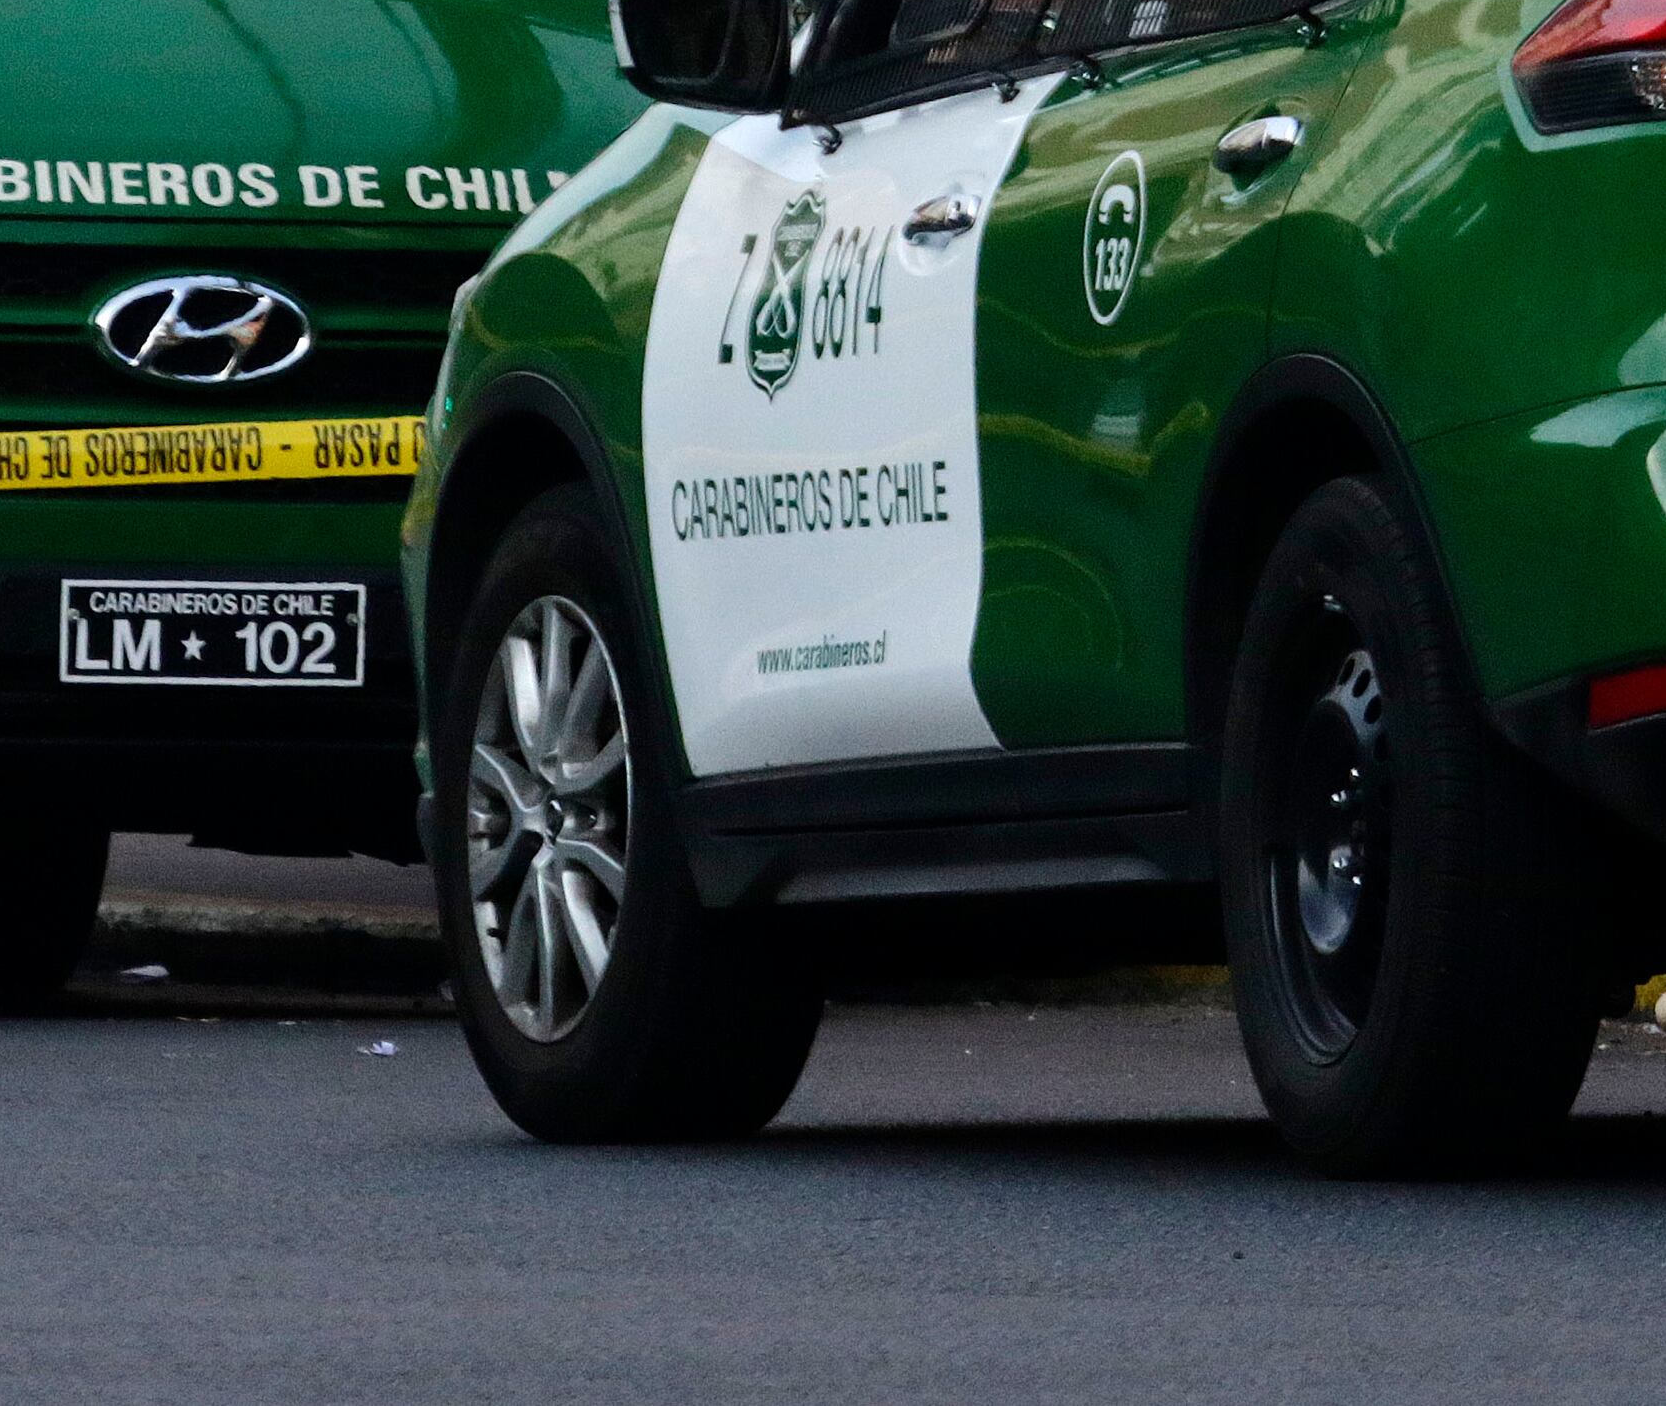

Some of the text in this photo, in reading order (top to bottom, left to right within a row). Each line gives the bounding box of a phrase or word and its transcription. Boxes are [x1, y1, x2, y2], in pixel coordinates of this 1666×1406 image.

[298, 165, 385, 209] DE
[1094, 237, 1132, 291] 133
[41, 435, 72, 478] DE
[85, 426, 262, 476] CARABINEROS
[313, 423, 400, 469] PASAR
[671, 460, 949, 542] CARABINEROS DE CHILE
[89, 591, 336, 617] CARABINEROS DE CHILE
[74, 617, 337, 674] LM 102
[757, 628, 887, 674] www.carabineros.cl
